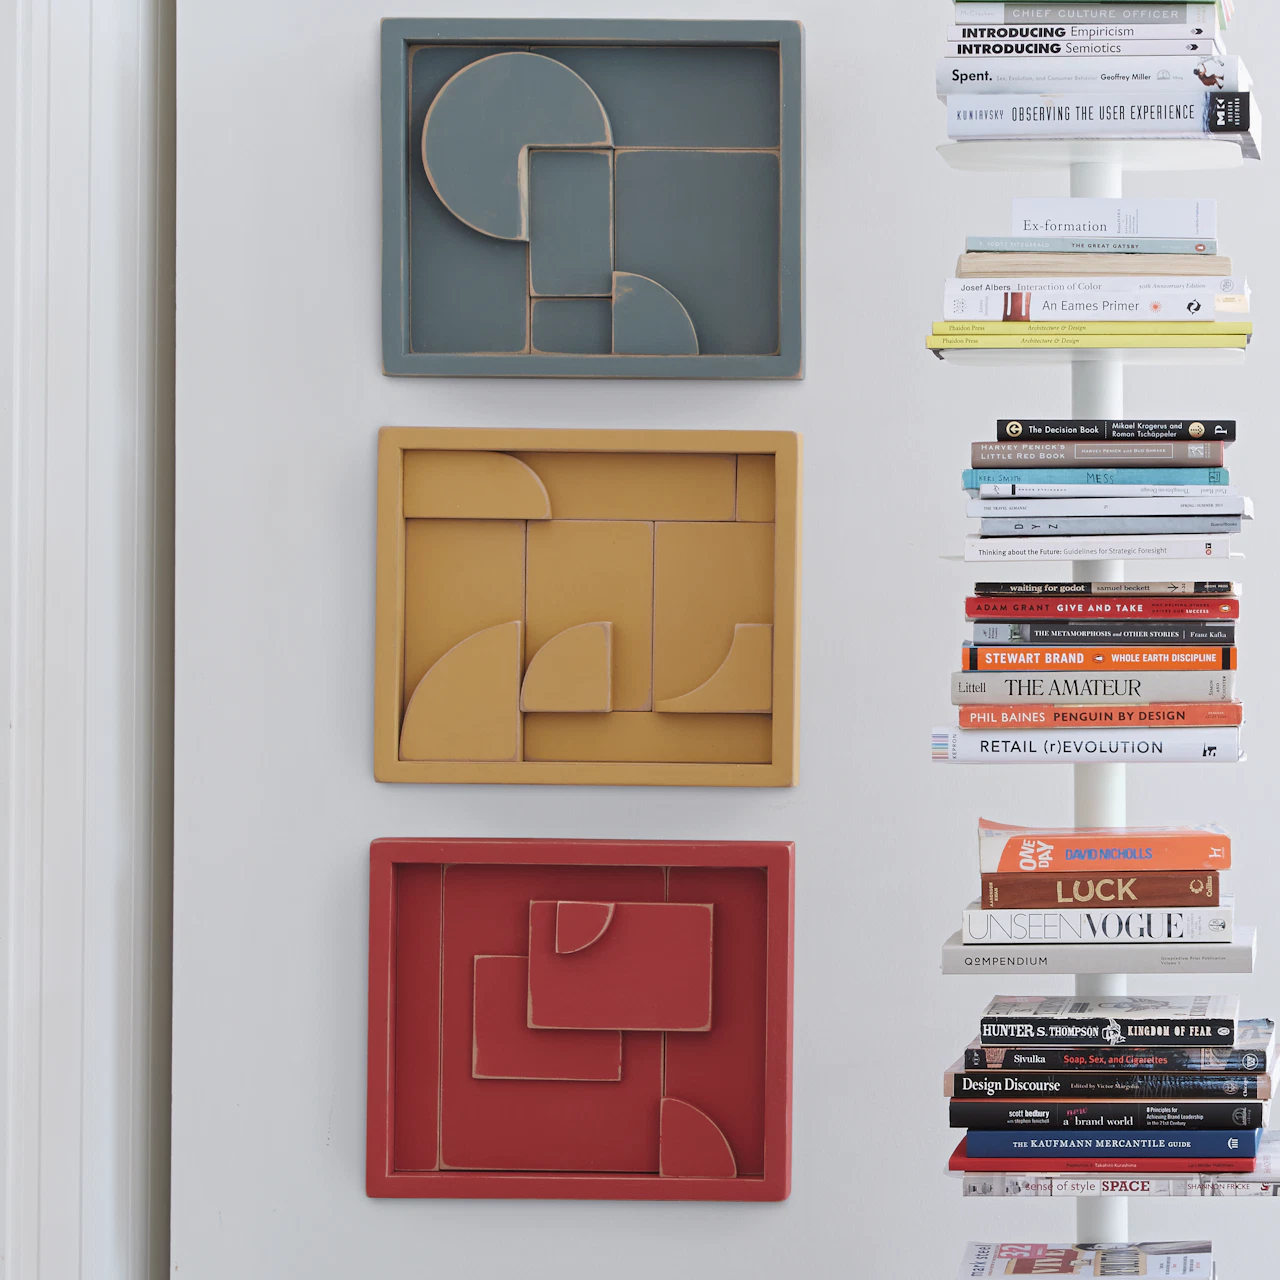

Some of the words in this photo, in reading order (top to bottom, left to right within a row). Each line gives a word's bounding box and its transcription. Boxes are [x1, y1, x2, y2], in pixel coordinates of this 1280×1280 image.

[1013, 9, 1051, 18] CHIEF
[1058, 9, 1116, 18] CULTURE
[1123, 9, 1178, 19] OFFICER
[962, 27, 1066, 38] INTRODUCING
[1071, 26, 1134, 40] Empiricism
[957, 43, 1061, 54] INTRODUCING
[1065, 43, 1121, 54] Semiotics
[952, 70, 992, 83] Spent.
[1012, 107, 1070, 121] OBSERVING
[1076, 106, 1093, 121] THE
[1100, 106, 1125, 120] USER
[1130, 104, 1194, 120] EXPERIENCE
[1023, 219, 1107, 232] Ex-formation
[961, 284, 983, 293] Josef
[985, 284, 1010, 292] Albers
[1042, 301, 1056, 311] An
[1061, 301, 1098, 311] Eames
[1102, 301, 1139, 311] Primer
[1029, 426, 1042, 434] The
[1045, 426, 1077, 434] Decision
[1080, 426, 1099, 434] Book
[978, 549, 1005, 557] Thinking
[1008, 548, 1026, 556] about
[1109, 547, 1136, 556] Strategic
[1138, 547, 1167, 555] Foresight
[1010, 584, 1041, 593] waiting
[1044, 584, 1056, 592] for
[1059, 584, 1085, 593] godot
[1057, 604, 1083, 612] GIVE
[1088, 604, 1112, 612] AND
[1116, 604, 1143, 612] TAKE
[985, 653, 1039, 664] STEWART
[1045, 652, 1084, 663] BRAND
[1111, 654, 1140, 662] WHOLE
[1143, 654, 1169, 662] EARTH
[1172, 654, 1216, 662] DISCIPLINE
[1004, 679, 1045, 696] THE
[1049, 679, 1141, 696] AMATEUR
[970, 713, 998, 723] PHIL
[1001, 713, 1045, 723] BAINES
[1053, 712, 1112, 722] PENGUIN
[1118, 712, 1134, 721] BY
[1138, 711, 1185, 721] DESIGN
[981, 740, 1037, 753] RETAIL
[1044, 740, 1163, 754] (r)EVOLUTION
[1019, 839, 1036, 870] ONE
[1037, 841, 1053, 868] DAY
[1056, 878, 1138, 903] LUCK
[983, 1023, 1035, 1037] HUNTER
[1037, 1027, 1048, 1037] S.
[1050, 1027, 1099, 1037] THOMPSON
[1128, 1027, 1170, 1036] KINGDOM
[1174, 1027, 1185, 1036] OF
[1189, 1026, 1212, 1036] FEAR
[1064, 1055, 1086, 1066] Soap,
[1089, 1055, 1106, 1065] Sex,
[1108, 1055, 1124, 1064] and
[1126, 1054, 1168, 1065] Cigarettes
[962, 1077, 1002, 1095] Design
[1004, 1077, 1060, 1091] Discourse
[1031, 1139, 1092, 1148] KAUFMANN
[1096, 1139, 1165, 1148] MERCANTILE
